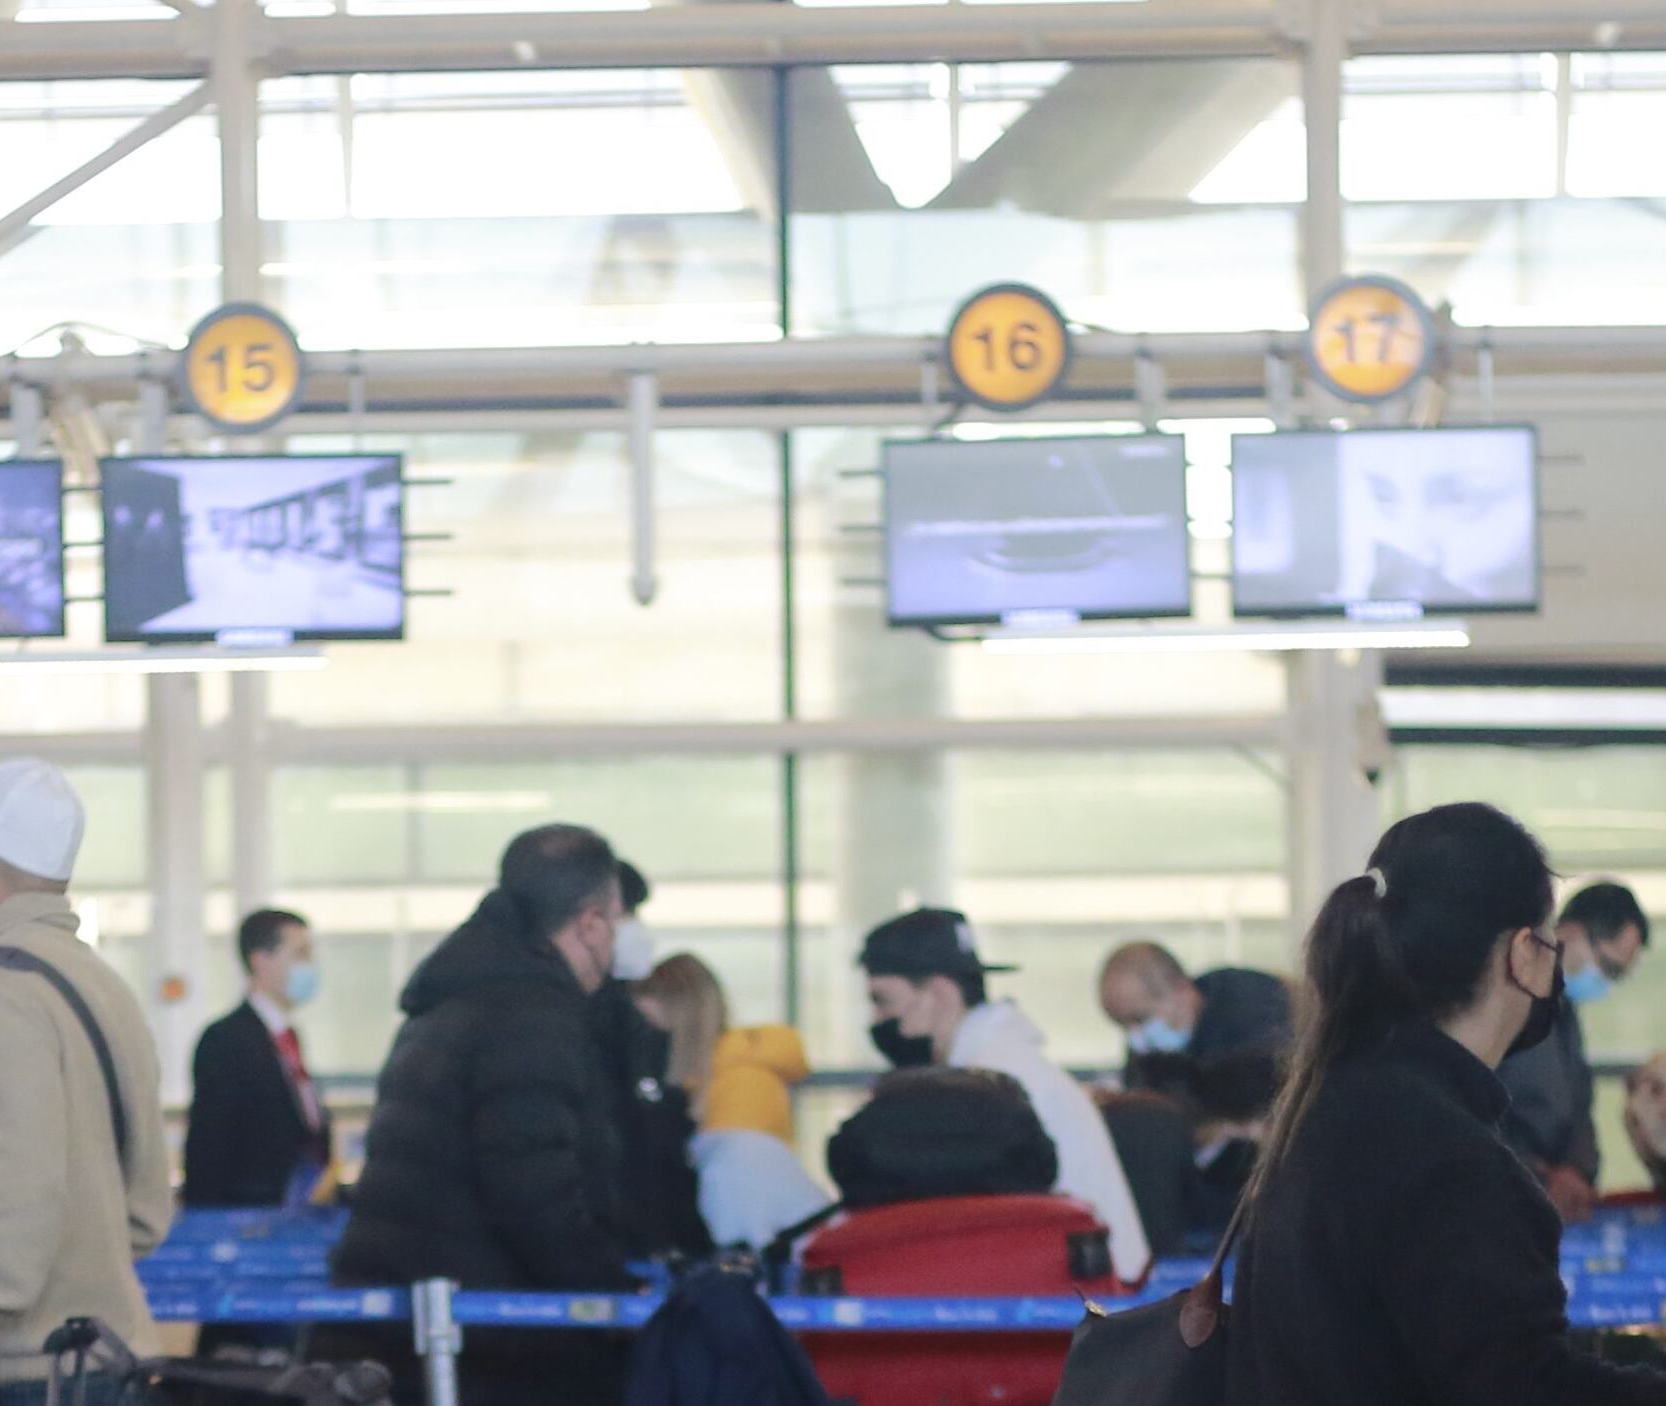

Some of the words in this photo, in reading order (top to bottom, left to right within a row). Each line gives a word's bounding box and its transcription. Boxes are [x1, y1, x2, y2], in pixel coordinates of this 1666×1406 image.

[972, 321, 1043, 372] 16
[1334, 310, 1402, 364] 17
[204, 343, 275, 392] 15
